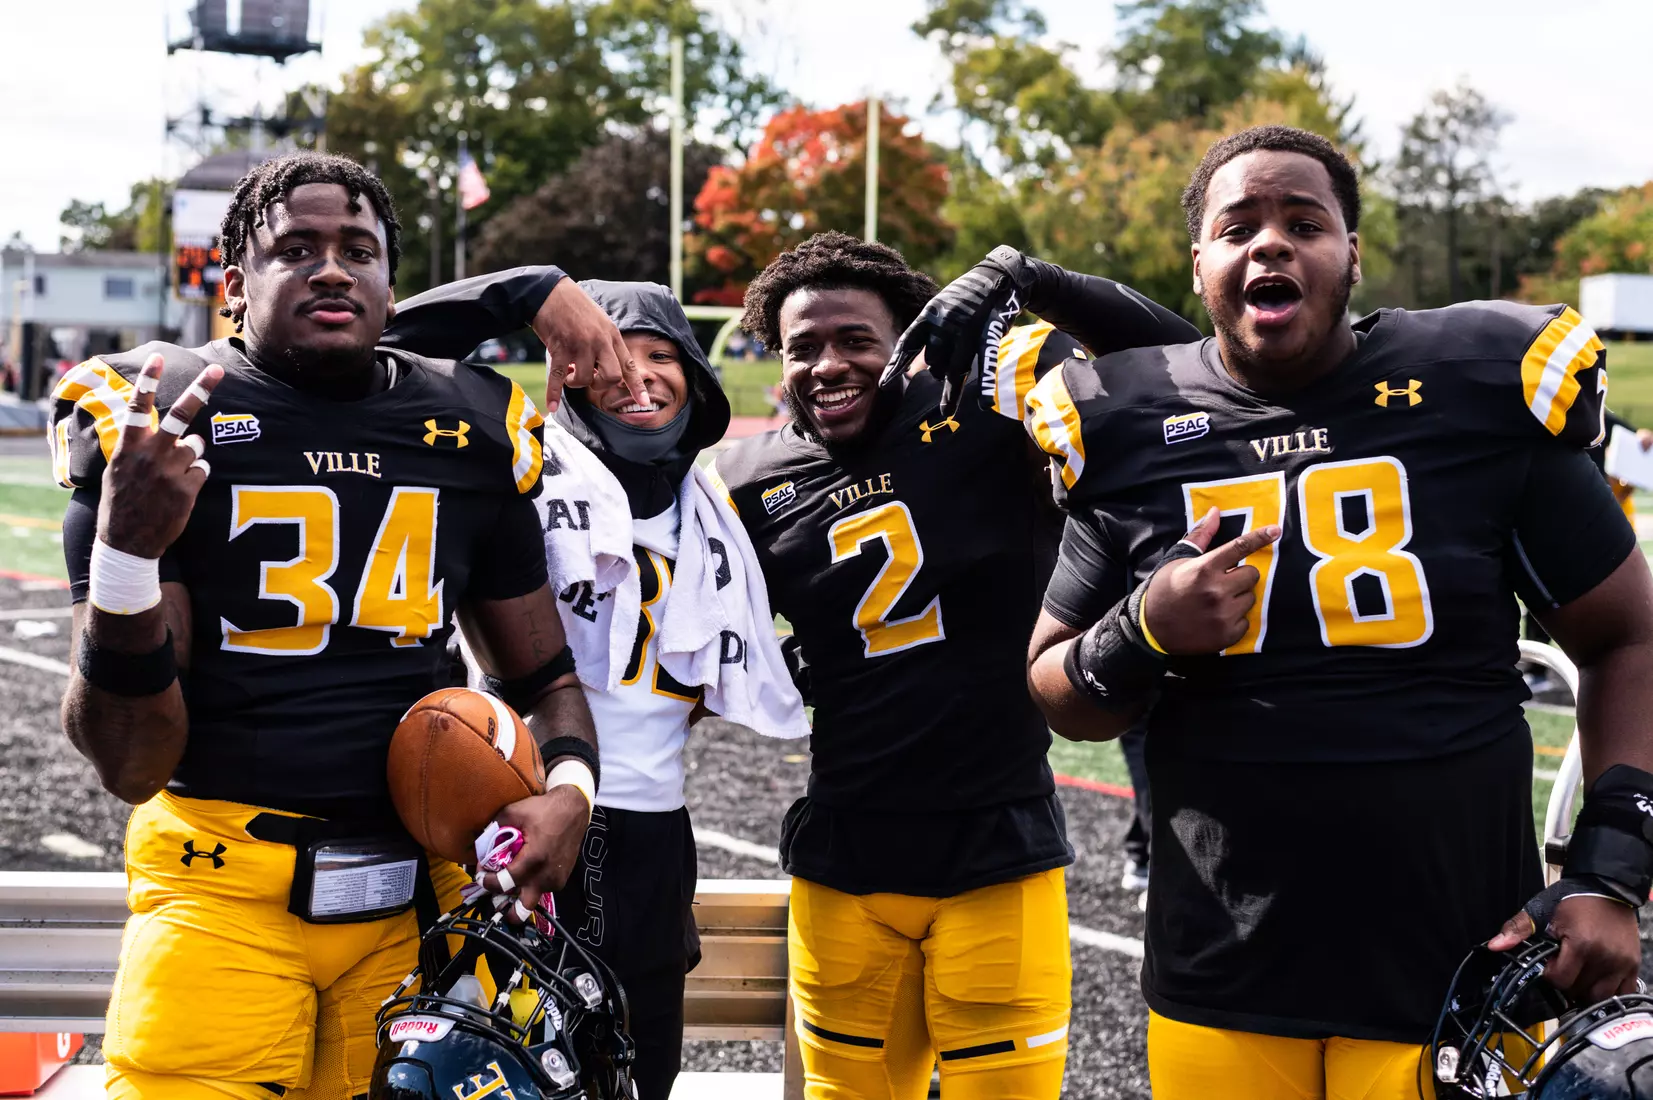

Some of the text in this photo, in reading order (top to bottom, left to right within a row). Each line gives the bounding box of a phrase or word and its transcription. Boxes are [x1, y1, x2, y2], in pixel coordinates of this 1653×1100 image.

[214, 420, 257, 437] PSAC
[1166, 417, 1206, 437] PSAC
[1250, 428, 1331, 462] VILLE
[303, 451, 382, 478] VILLE
[765, 485, 793, 508] PSAC
[828, 473, 894, 509] VILLE
[220, 485, 444, 656] 34
[1182, 456, 1434, 657] 78
[828, 500, 946, 658] 2
